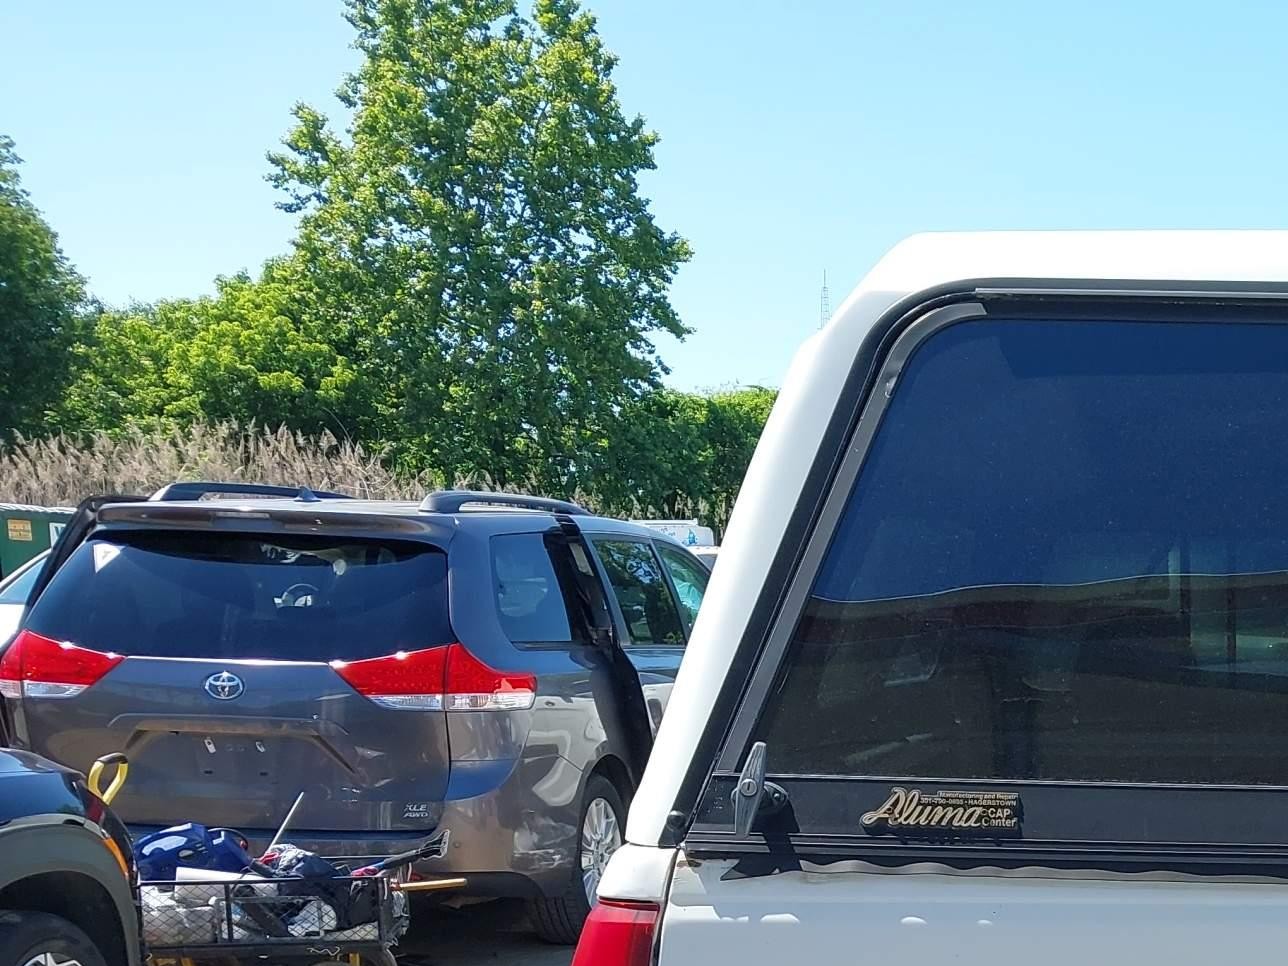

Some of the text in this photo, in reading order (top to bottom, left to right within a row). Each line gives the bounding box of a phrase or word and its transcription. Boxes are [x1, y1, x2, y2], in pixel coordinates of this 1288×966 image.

[860, 787, 983, 829] Aluma
[967, 799, 1017, 807] HAGERSTOWN
[988, 808, 1011, 818] CAP
[981, 817, 1018, 827] Center
